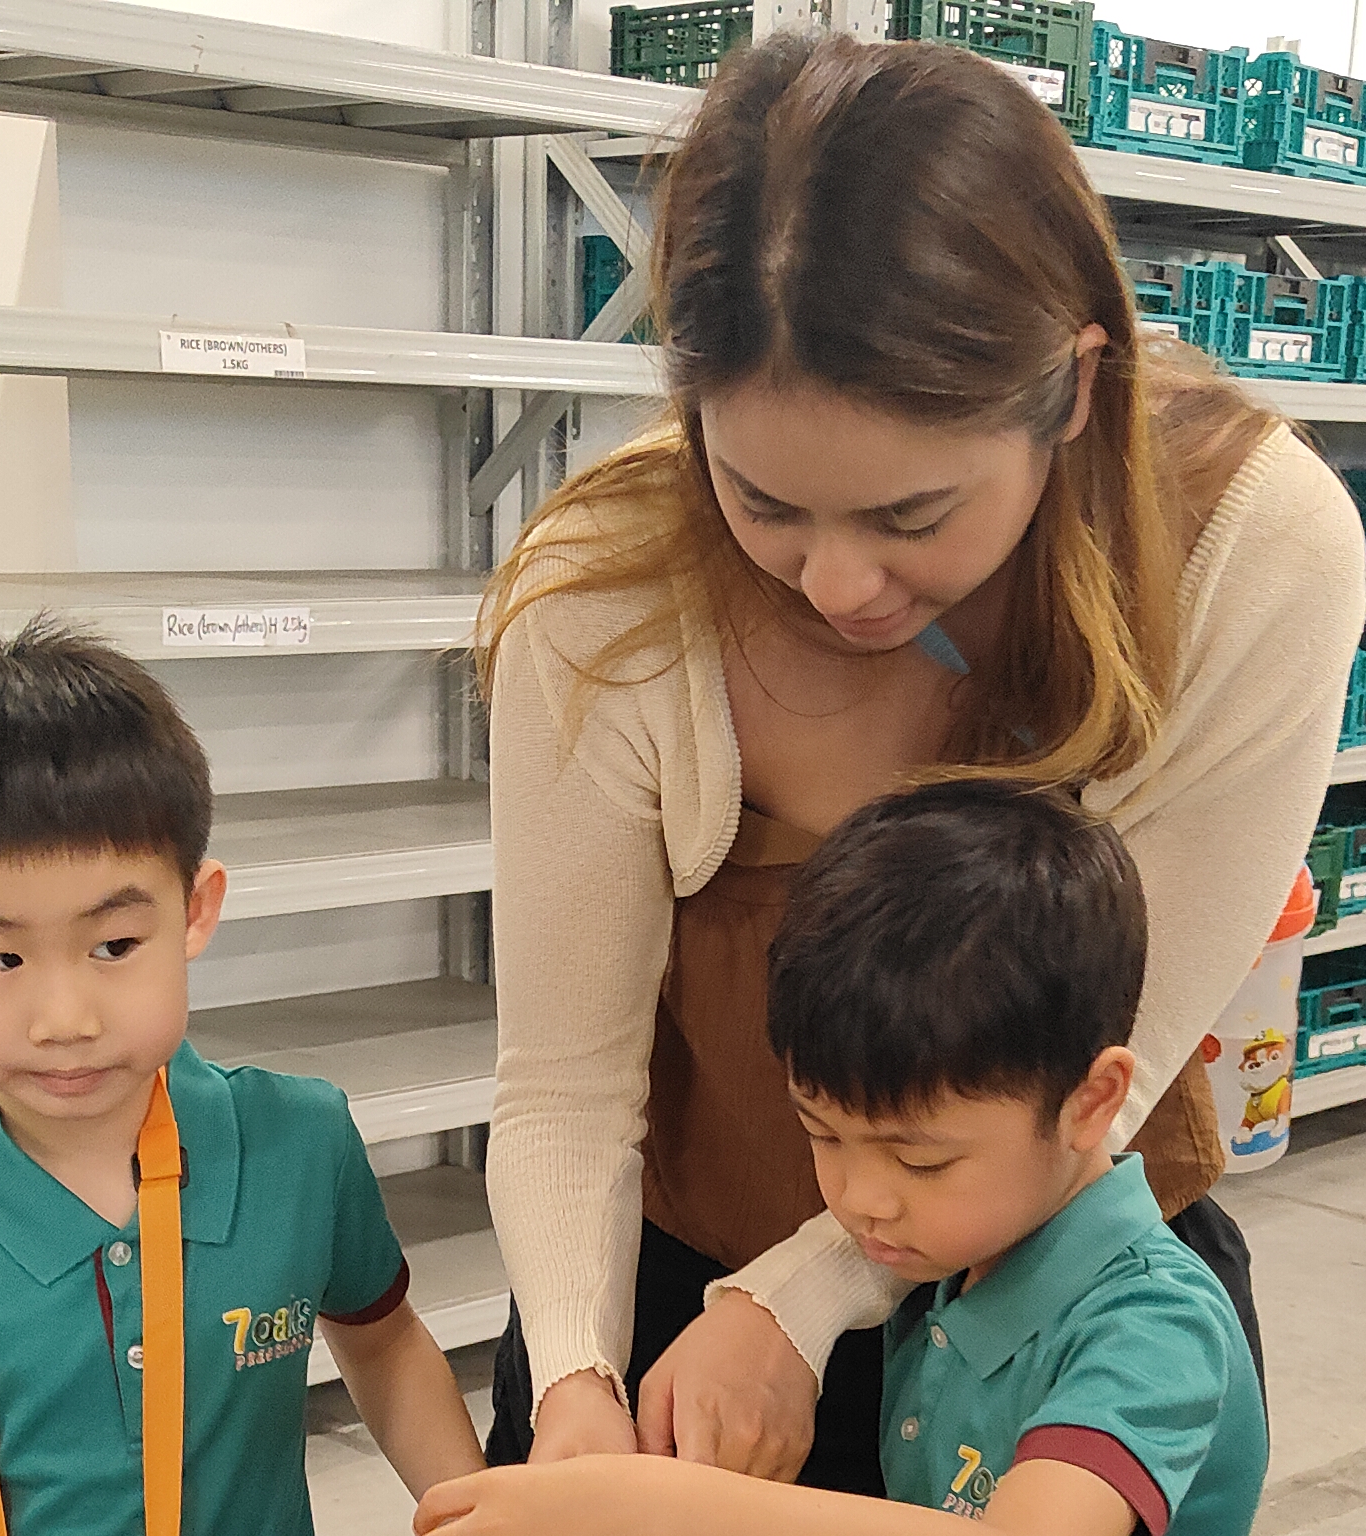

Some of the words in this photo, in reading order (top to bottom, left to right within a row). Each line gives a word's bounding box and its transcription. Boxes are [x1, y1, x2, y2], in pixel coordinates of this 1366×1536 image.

[180, 338, 201, 350] RICE
[203, 340, 287, 356] (BROWN/OTHERS)
[222, 358, 249, 370] 1.5KG
[167, 613, 194, 637] Rice
